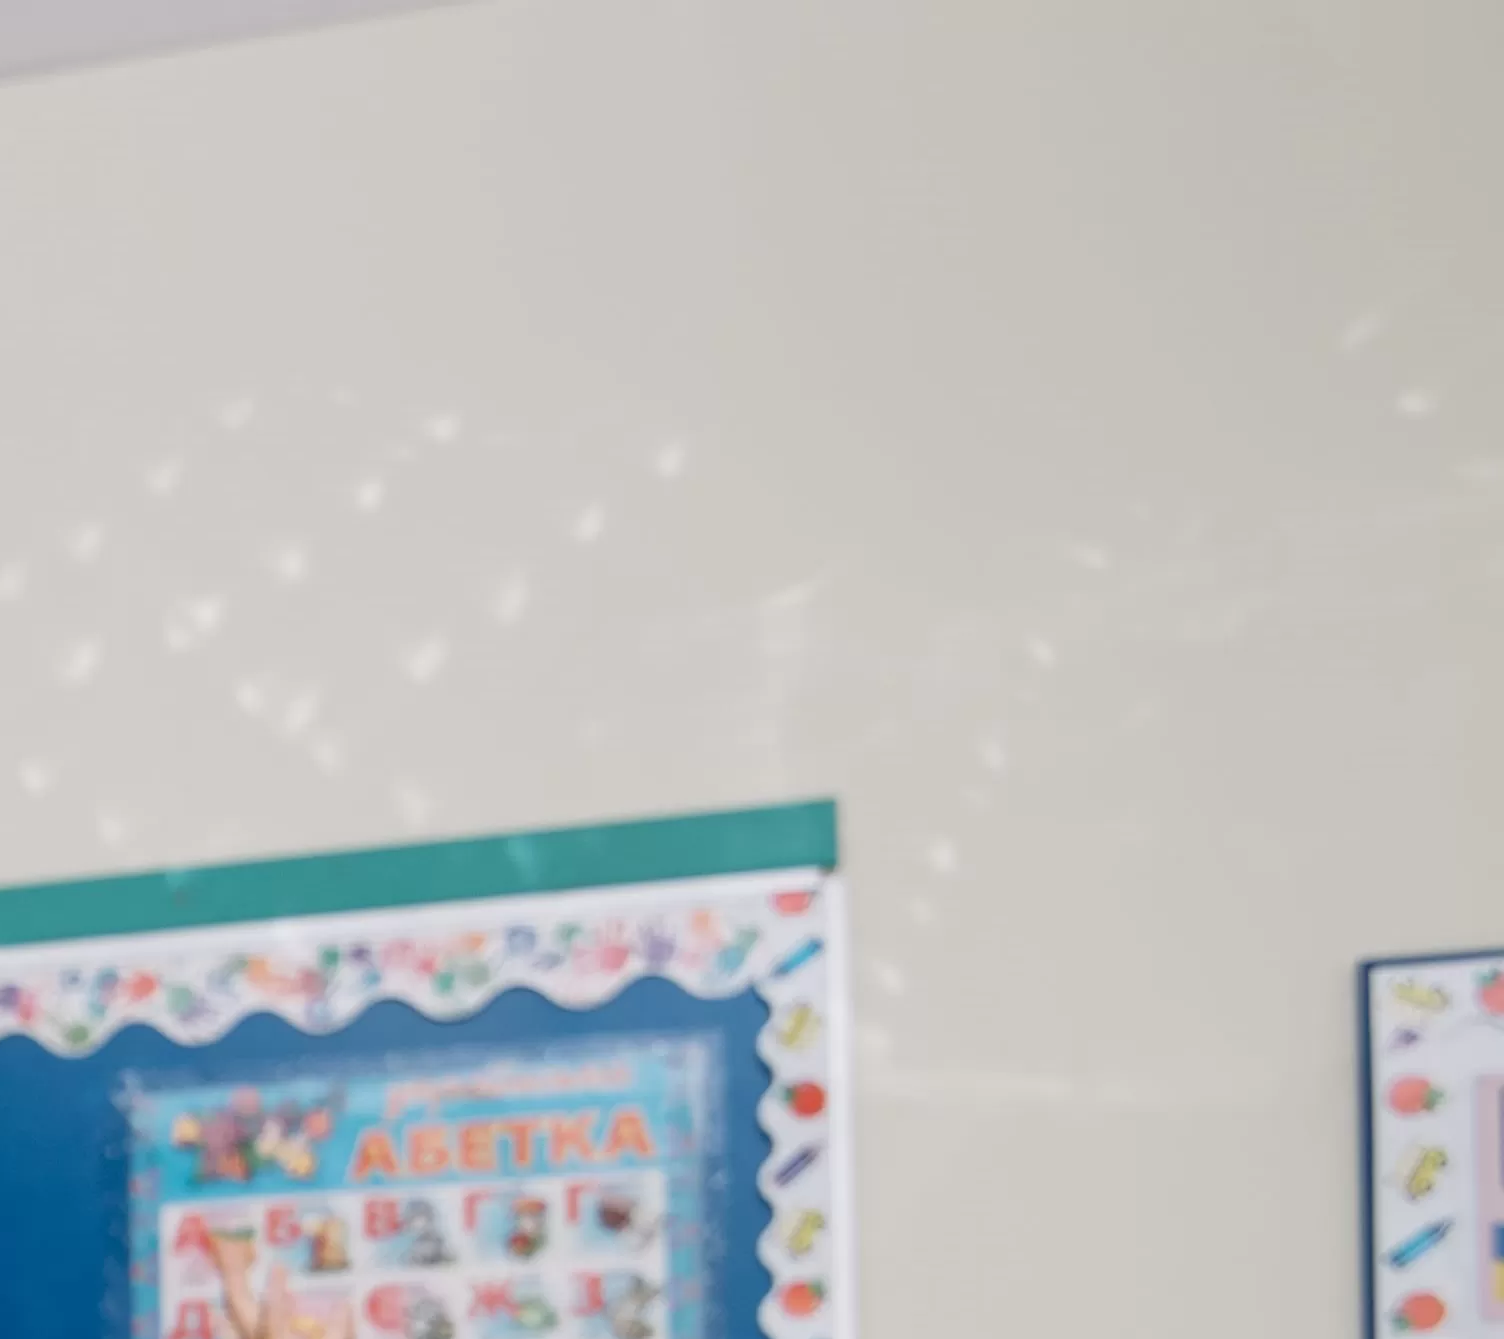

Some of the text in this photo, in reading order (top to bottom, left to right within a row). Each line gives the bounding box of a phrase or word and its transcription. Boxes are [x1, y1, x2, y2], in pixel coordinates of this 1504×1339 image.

[352, 1106, 655, 1180] АБЕТКА
[363, 1197, 405, 1241] В
[464, 1187, 493, 1232] Г
